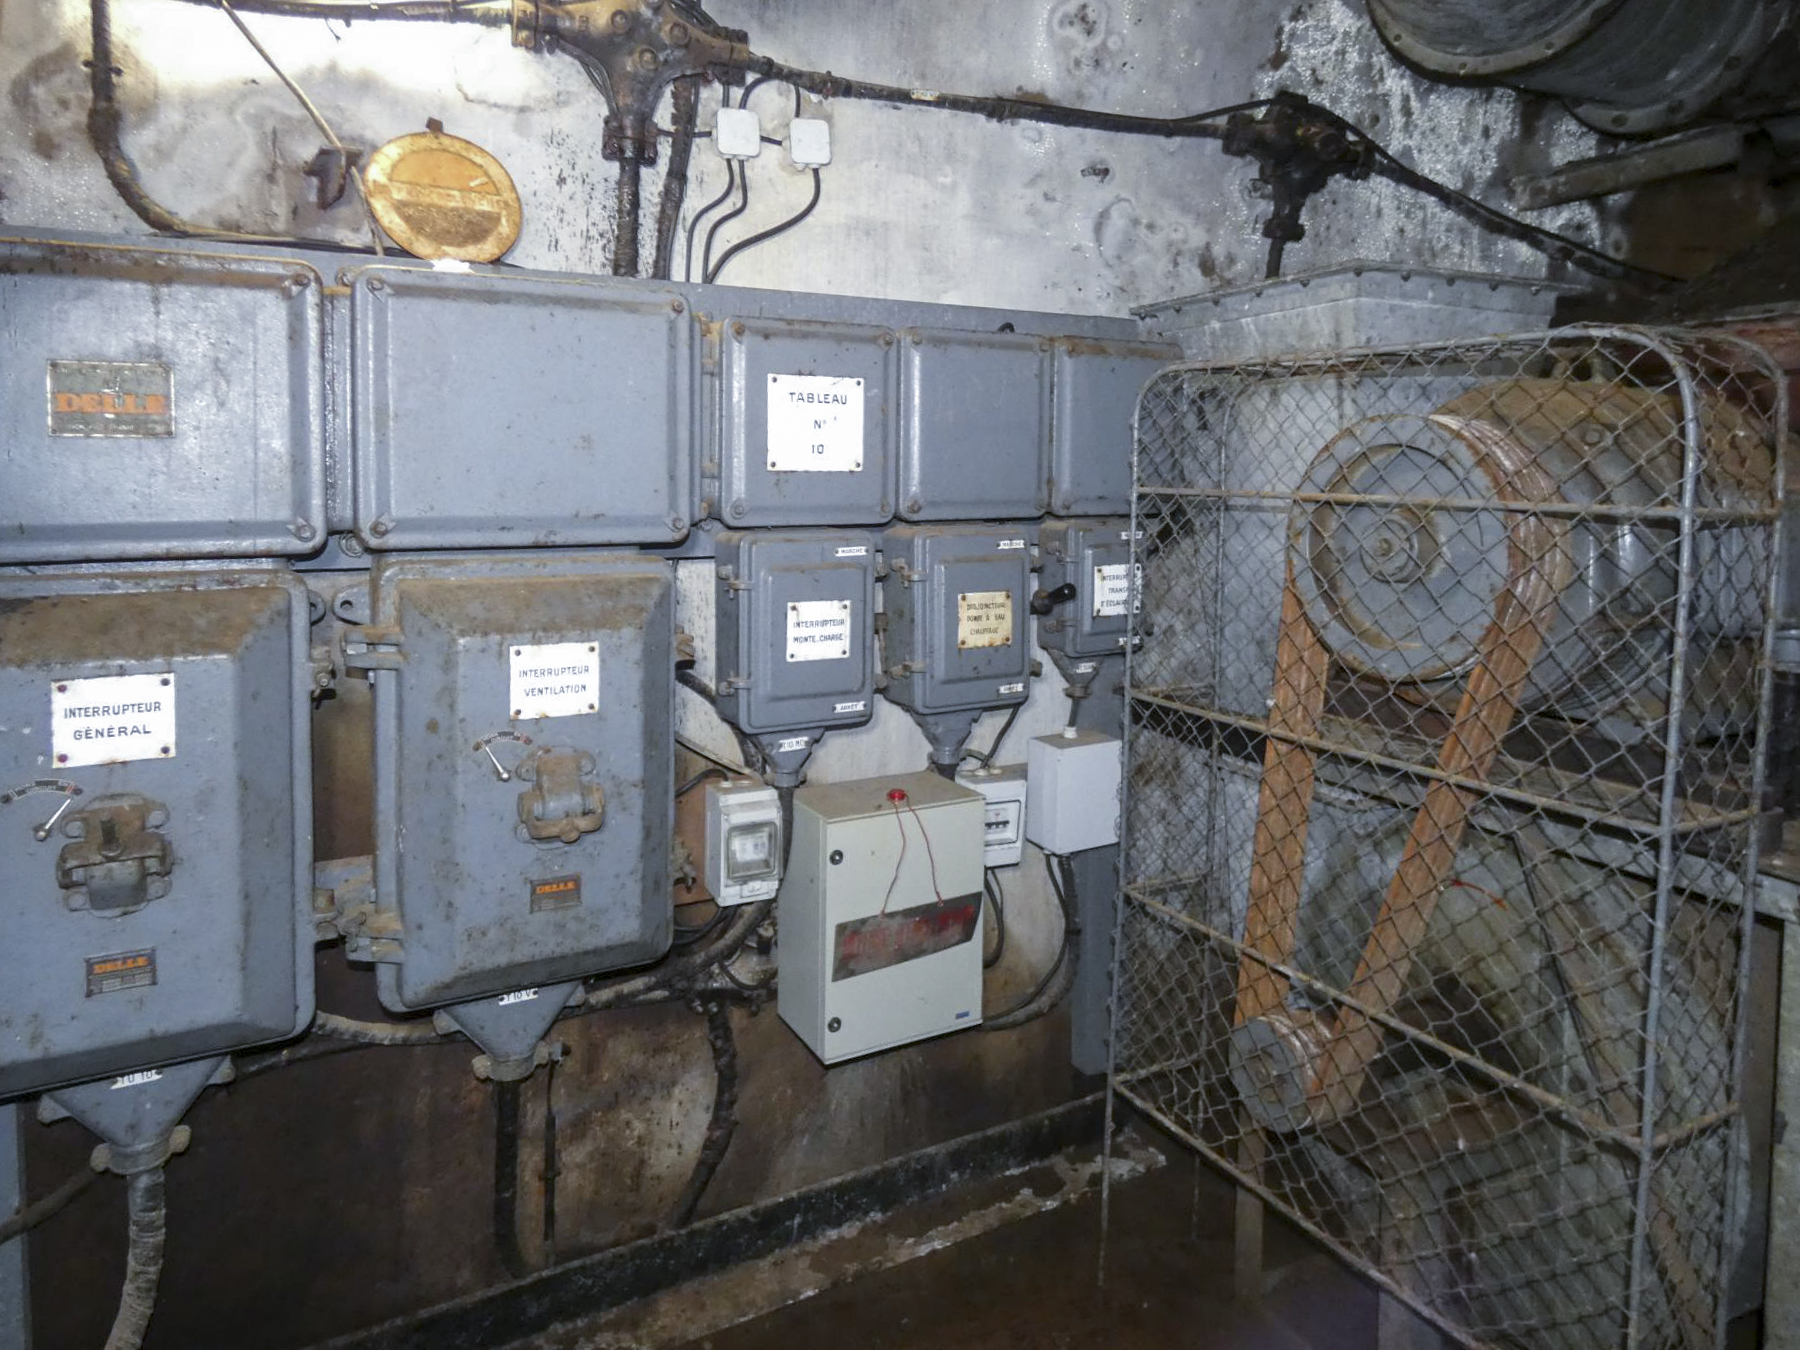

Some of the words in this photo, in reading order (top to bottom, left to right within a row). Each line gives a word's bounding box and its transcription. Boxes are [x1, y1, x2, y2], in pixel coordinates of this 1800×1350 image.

[788, 392, 848, 405] TABLEAU
[811, 443, 825, 455] 10
[793, 618, 845, 629] INTERRUPTEUR
[519, 664, 589, 678] INTERRUPTEUR
[524, 683, 587, 697] VENTILATION
[64, 701, 161, 719] INTERRUPTEUR
